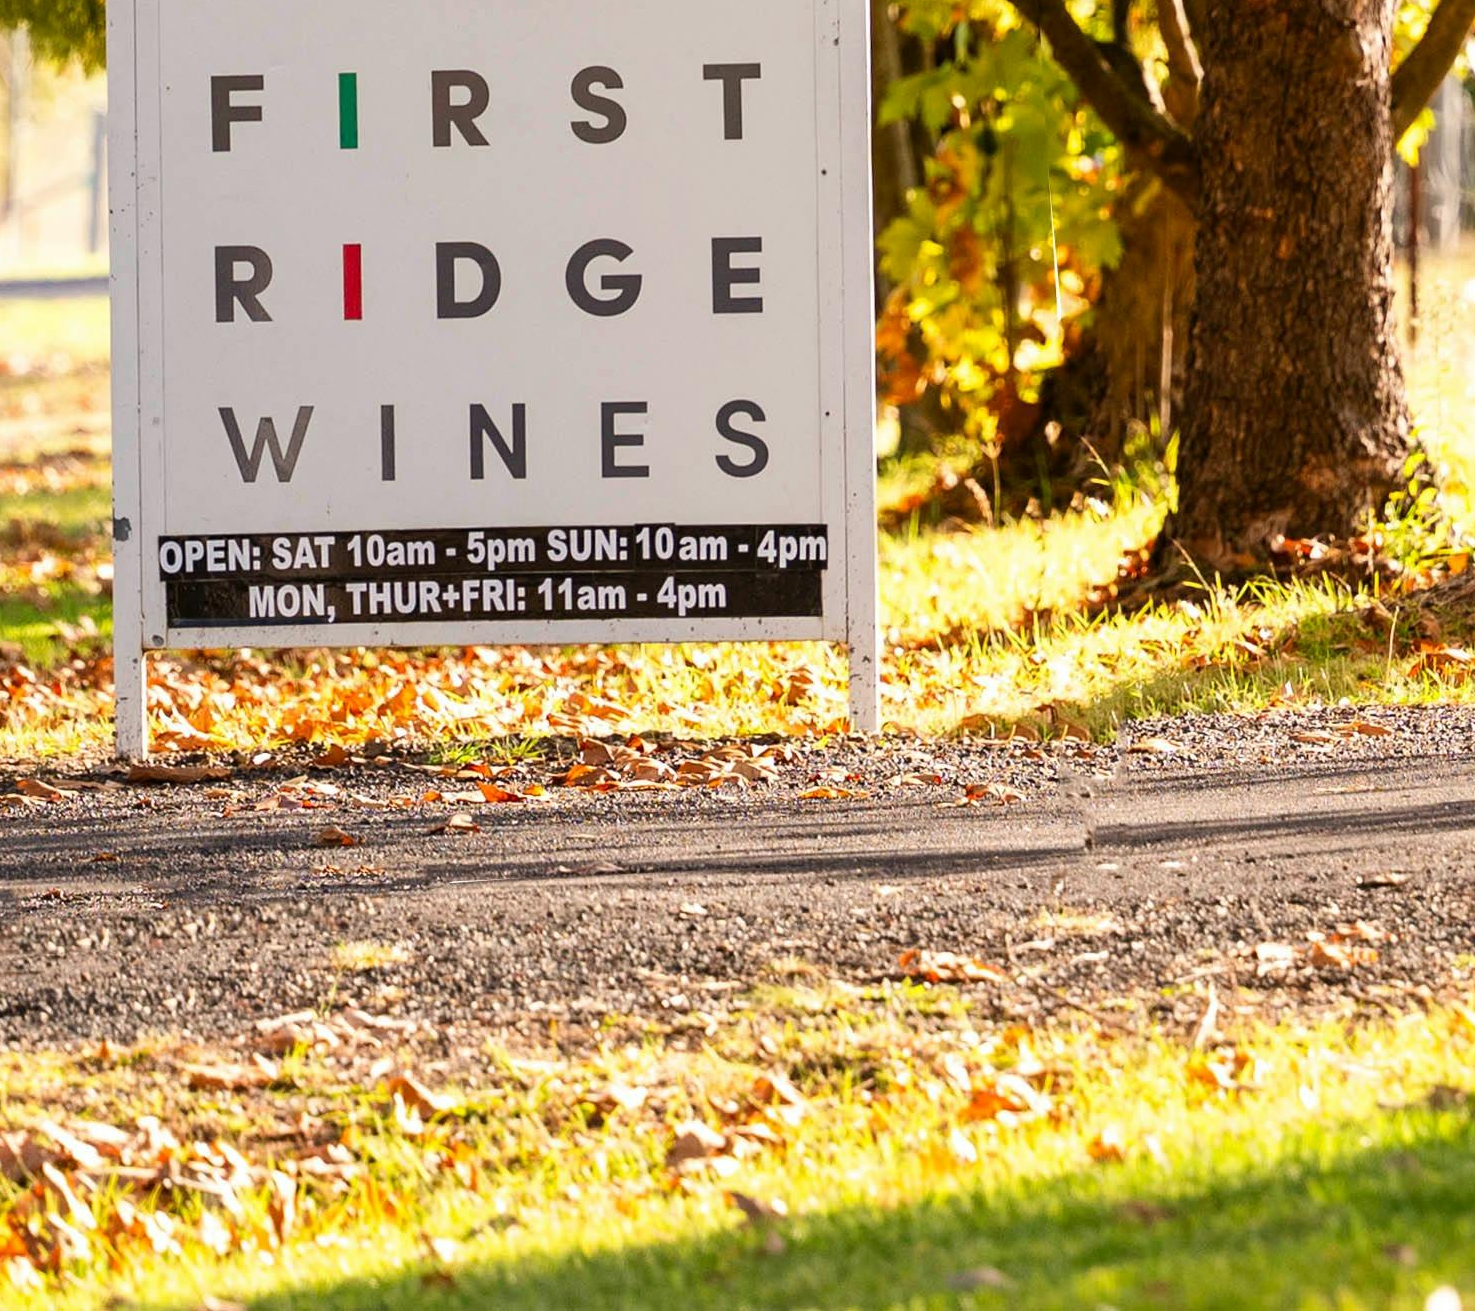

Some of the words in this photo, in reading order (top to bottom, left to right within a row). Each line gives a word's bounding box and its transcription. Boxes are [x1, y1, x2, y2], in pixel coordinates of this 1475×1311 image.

[211, 63, 762, 153] FIRST
[215, 236, 764, 323] RIDGE
[218, 399, 769, 484] WINES
[159, 538, 261, 574] OPEN:
[272, 536, 336, 571] SAT
[347, 534, 436, 567] 10am
[467, 531, 536, 571] 5pm
[547, 529, 628, 562] SUN:
[635, 527, 728, 562] 10am
[757, 530, 828, 569] 4pm
[249, 584, 336, 623] MON,
[345, 579, 526, 616] THUR+FRI:
[538, 577, 626, 611] 11am
[657, 576, 727, 617] 4pm
